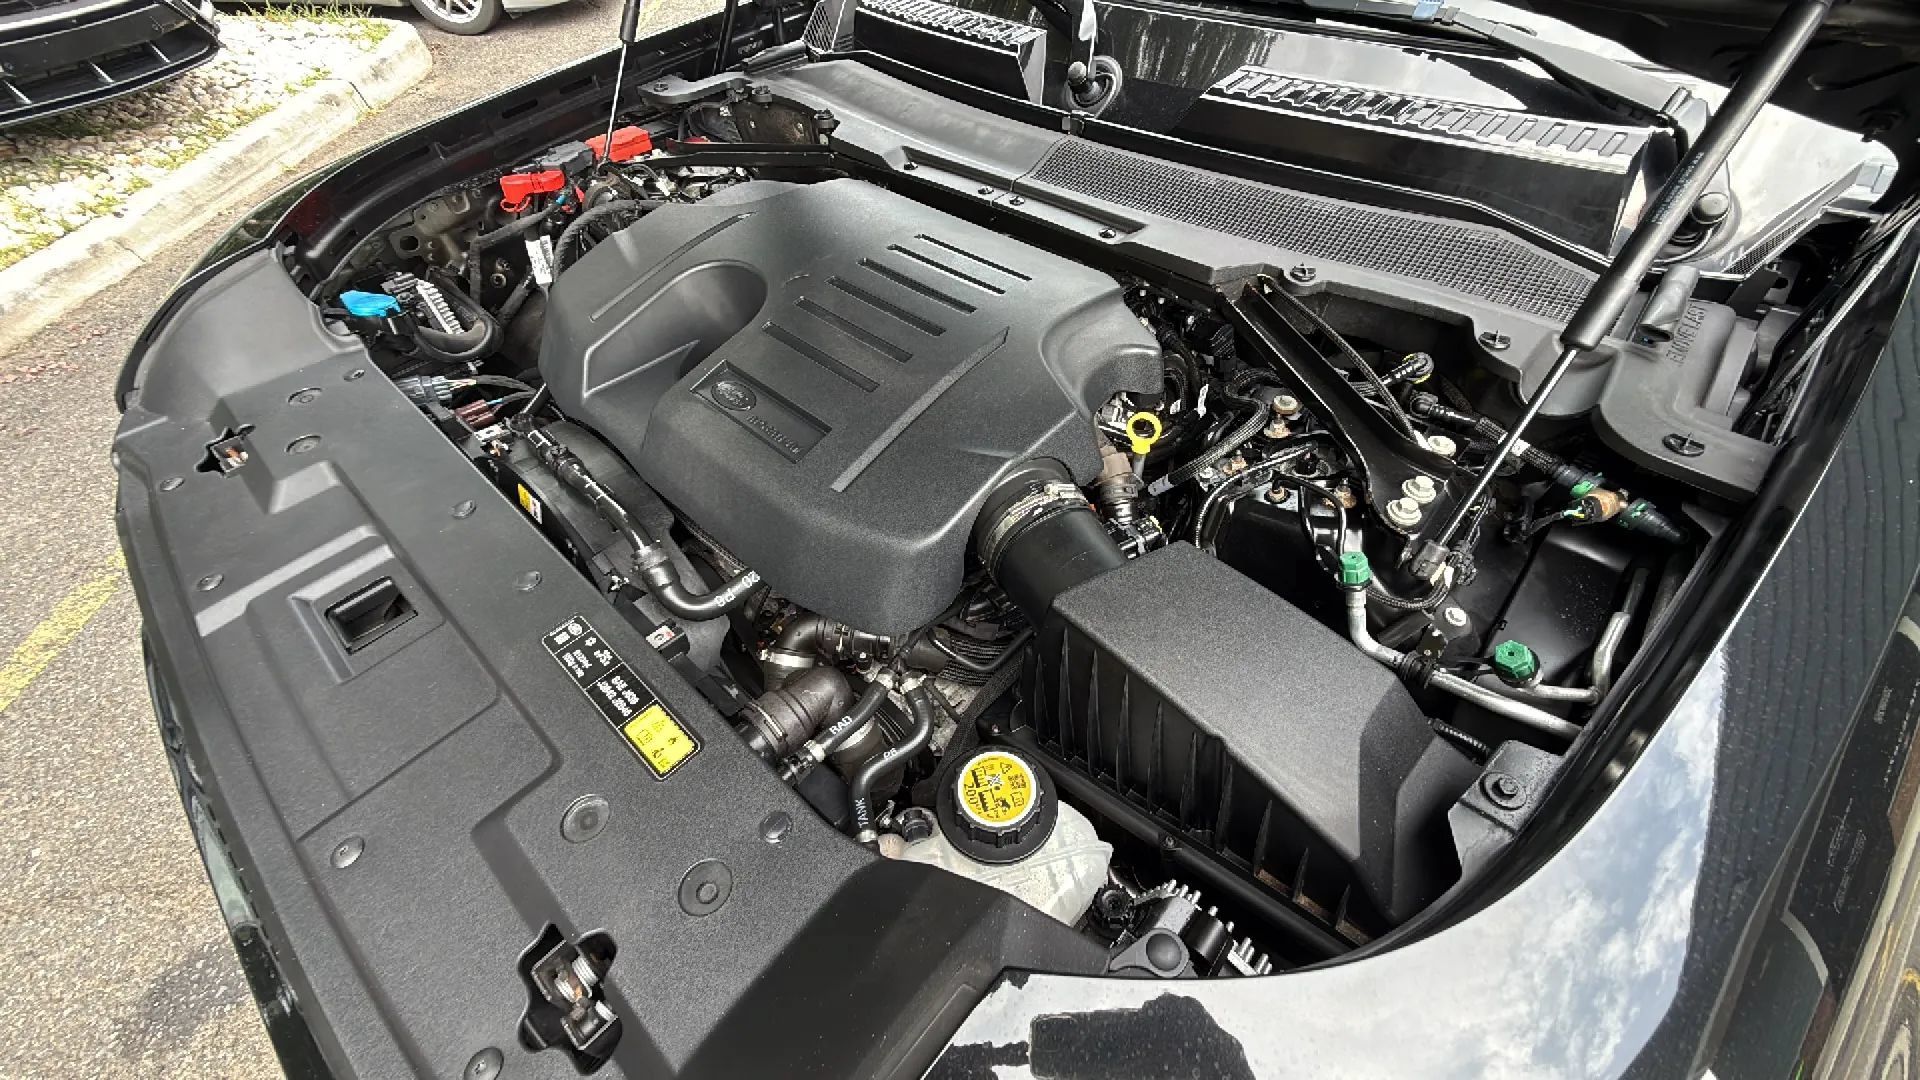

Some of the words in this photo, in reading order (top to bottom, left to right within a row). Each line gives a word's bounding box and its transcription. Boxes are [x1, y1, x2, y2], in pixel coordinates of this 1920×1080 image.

[828, 715, 853, 735] RAD
[964, 784, 979, 805] 200
[857, 797, 867, 828] TANK
